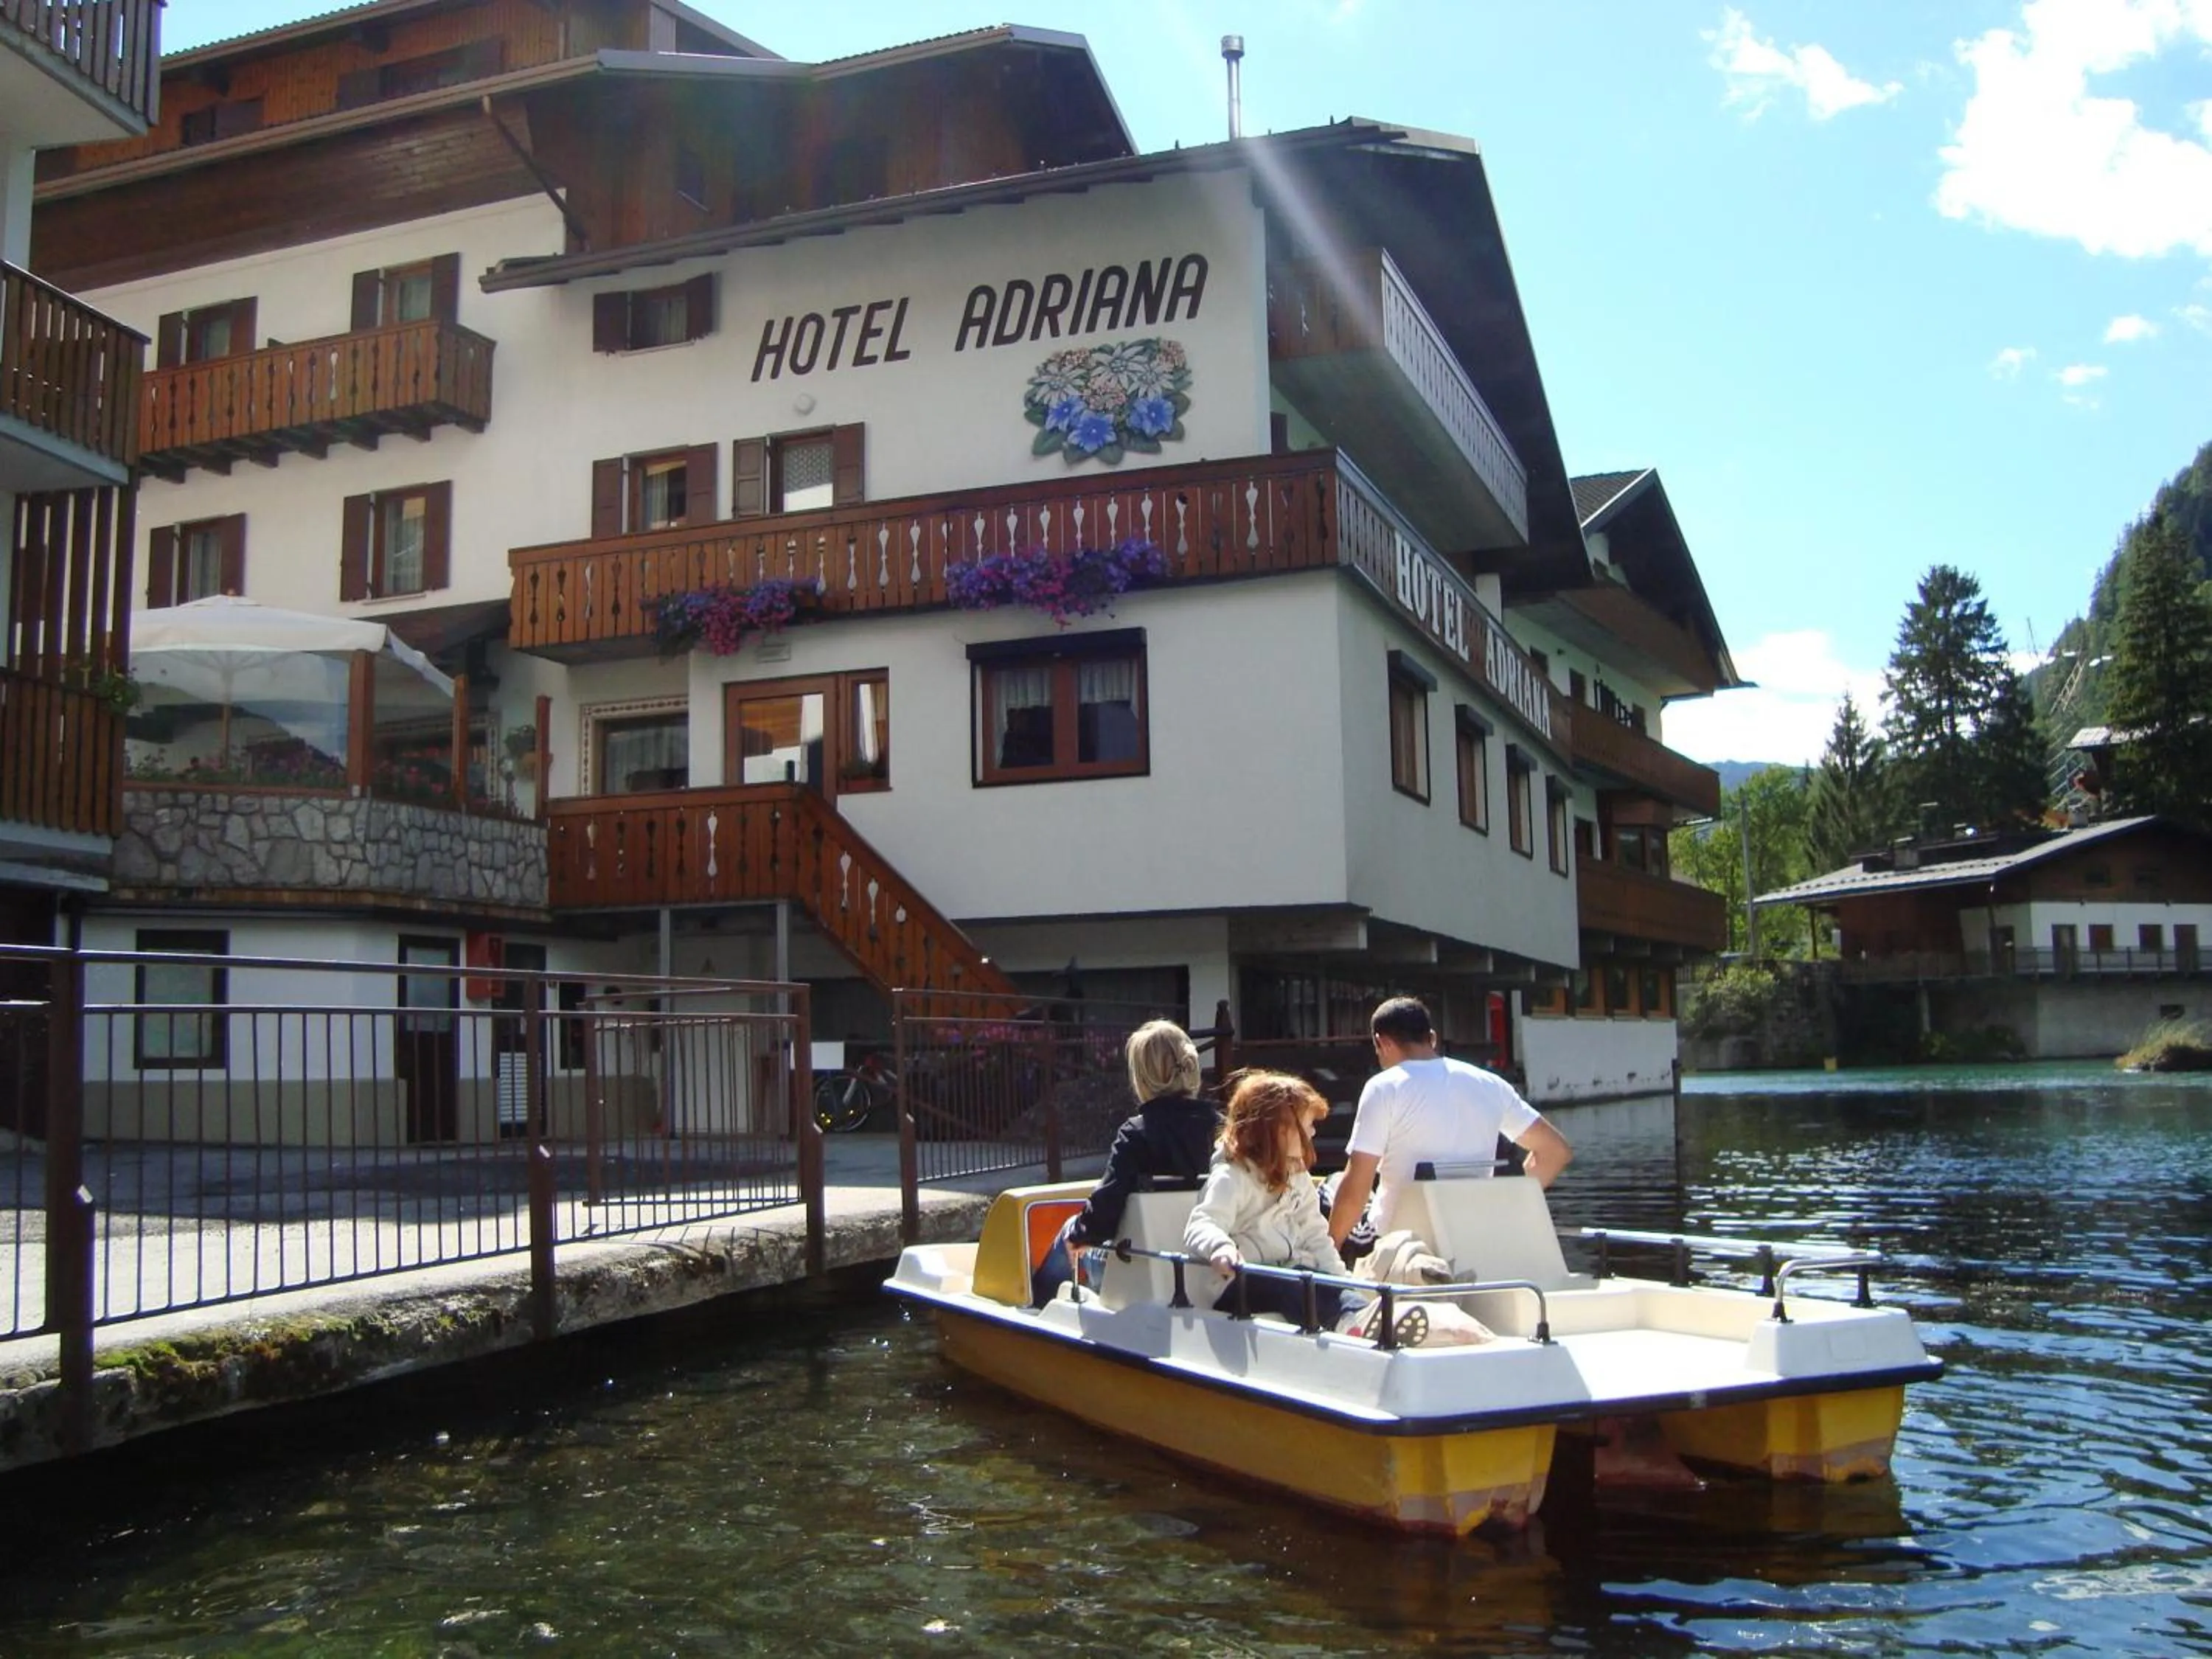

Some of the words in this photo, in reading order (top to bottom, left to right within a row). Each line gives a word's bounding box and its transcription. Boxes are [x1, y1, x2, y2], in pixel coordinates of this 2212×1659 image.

[751, 296, 911, 383] HOTEL
[954, 252, 1209, 352] ADRIANA
[1395, 530, 1470, 661] HOTEL
[1486, 627, 1552, 740] ADRIANA
